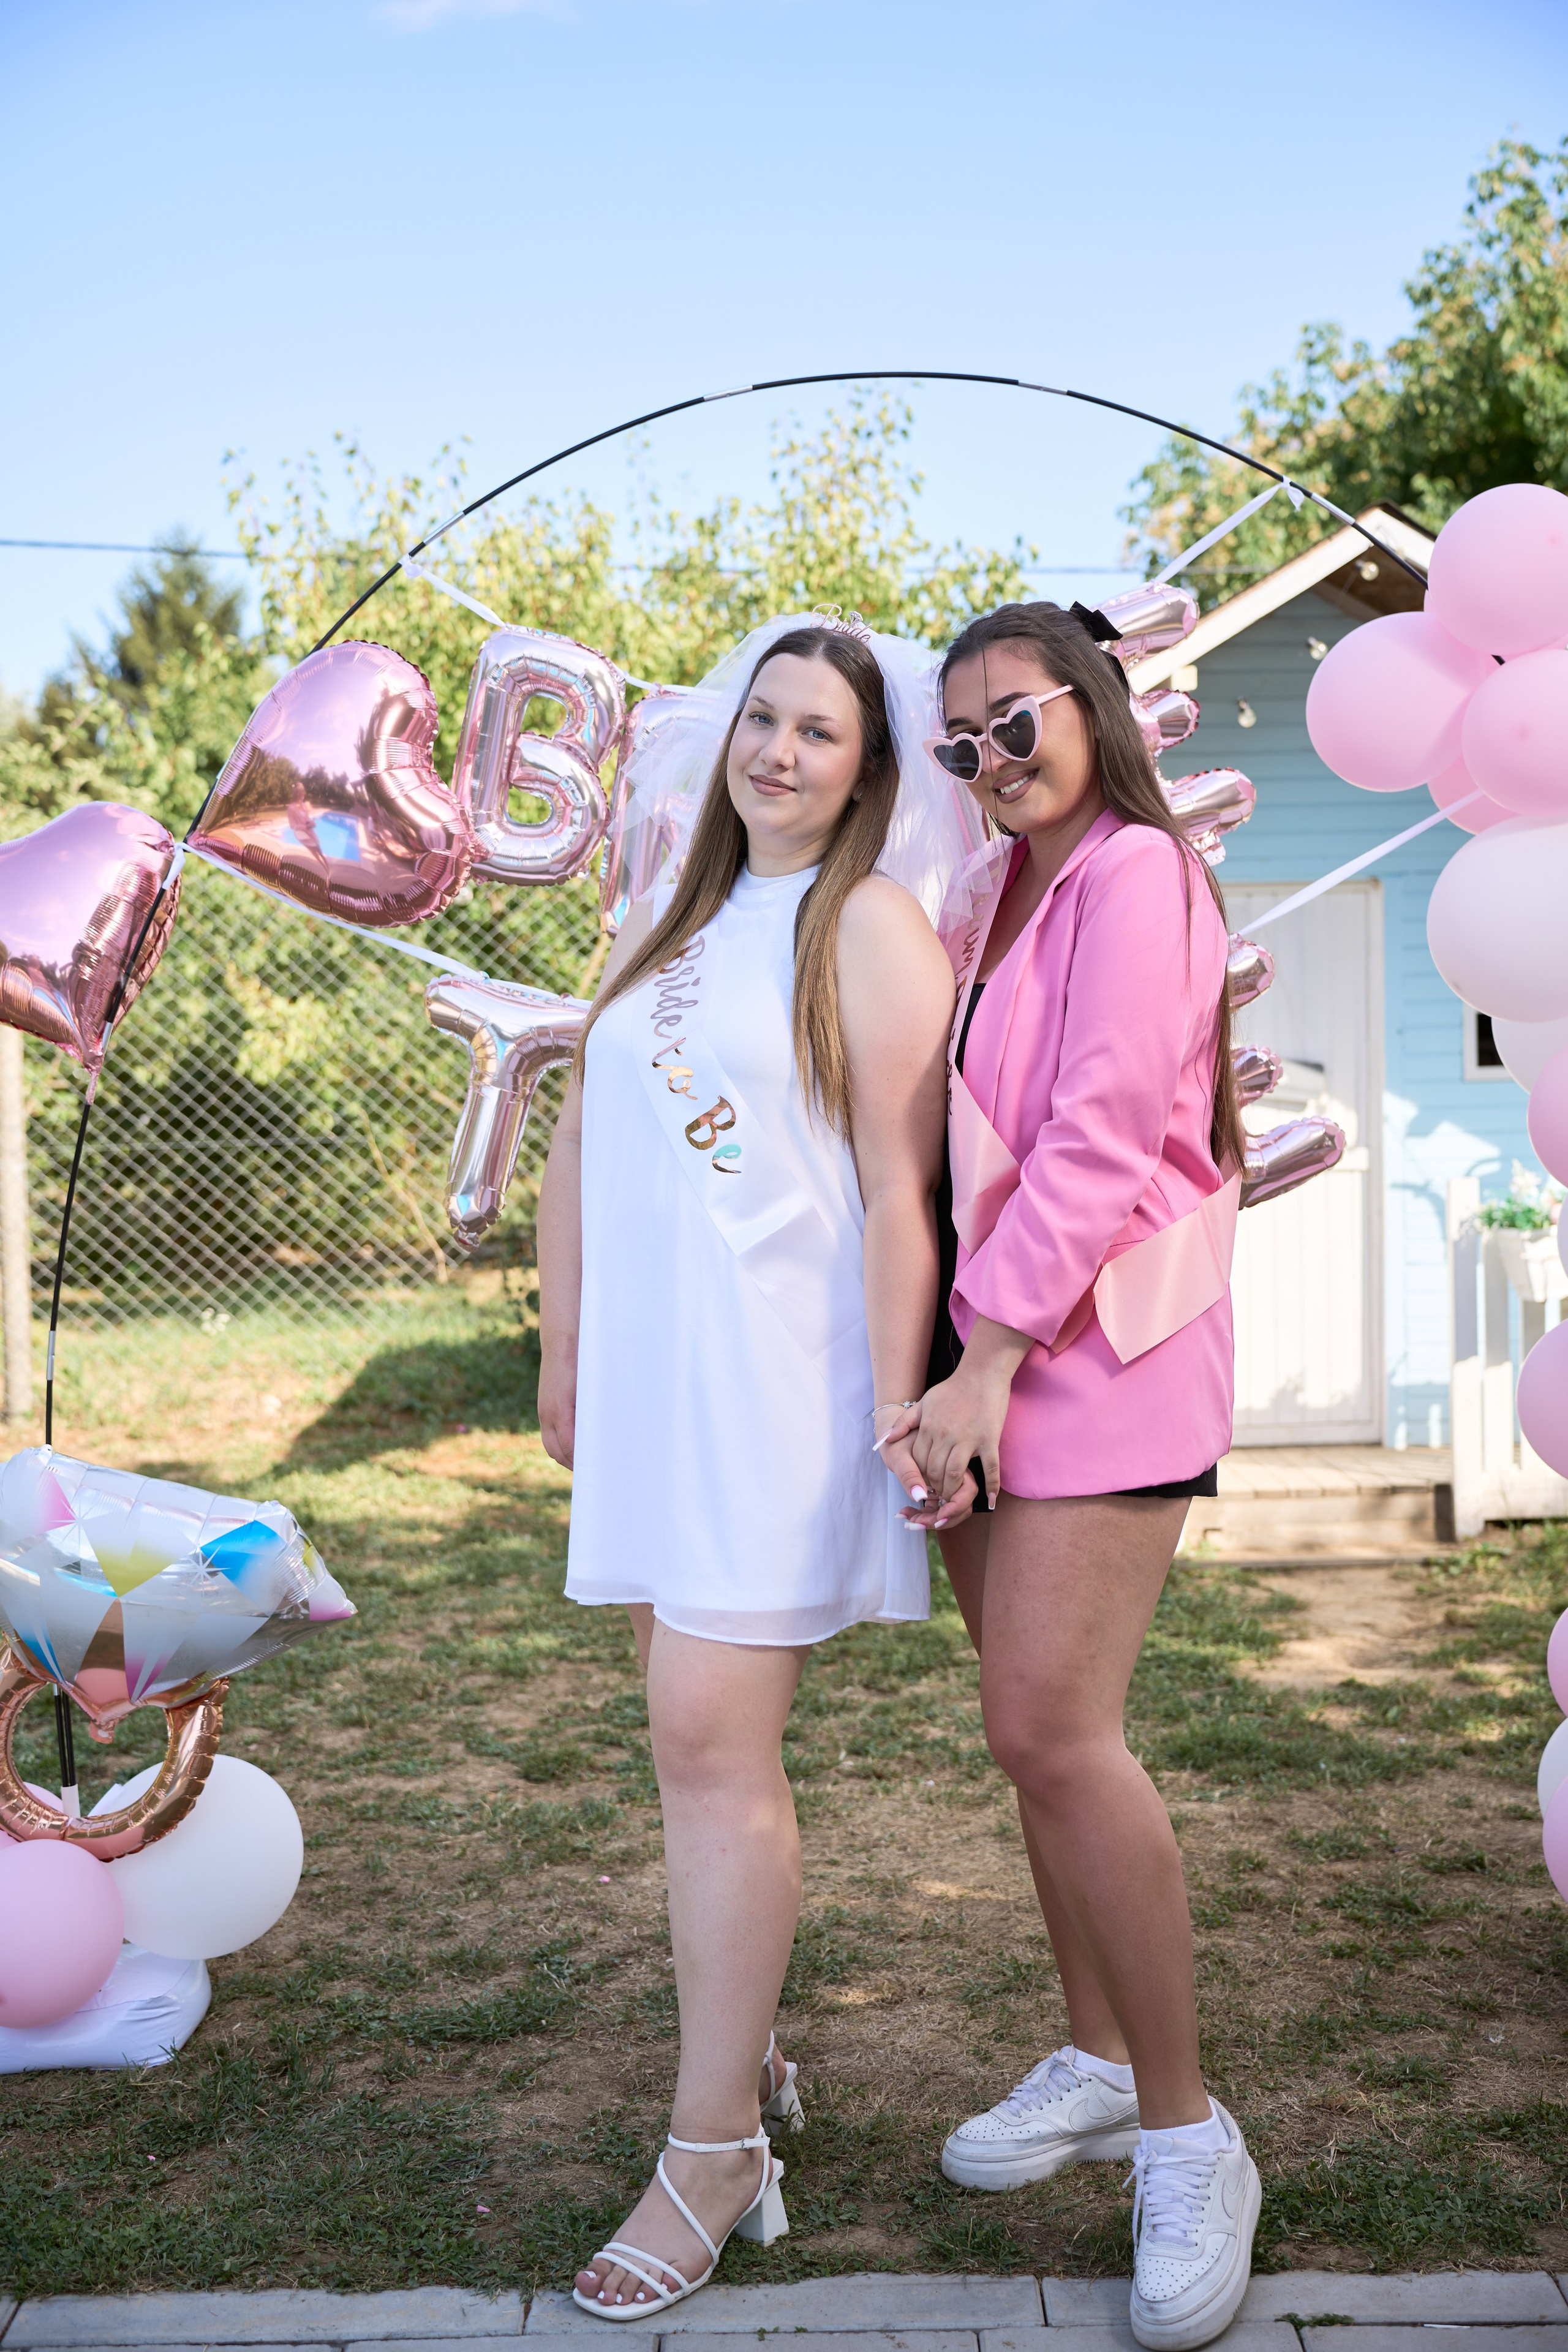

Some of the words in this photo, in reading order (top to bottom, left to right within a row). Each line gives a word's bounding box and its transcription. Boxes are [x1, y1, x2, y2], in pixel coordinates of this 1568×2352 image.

[810, 602, 873, 644] Bride
[650, 934, 706, 1039] Bride
[652, 1037, 698, 1101] to
[684, 1095, 742, 1174] Be
